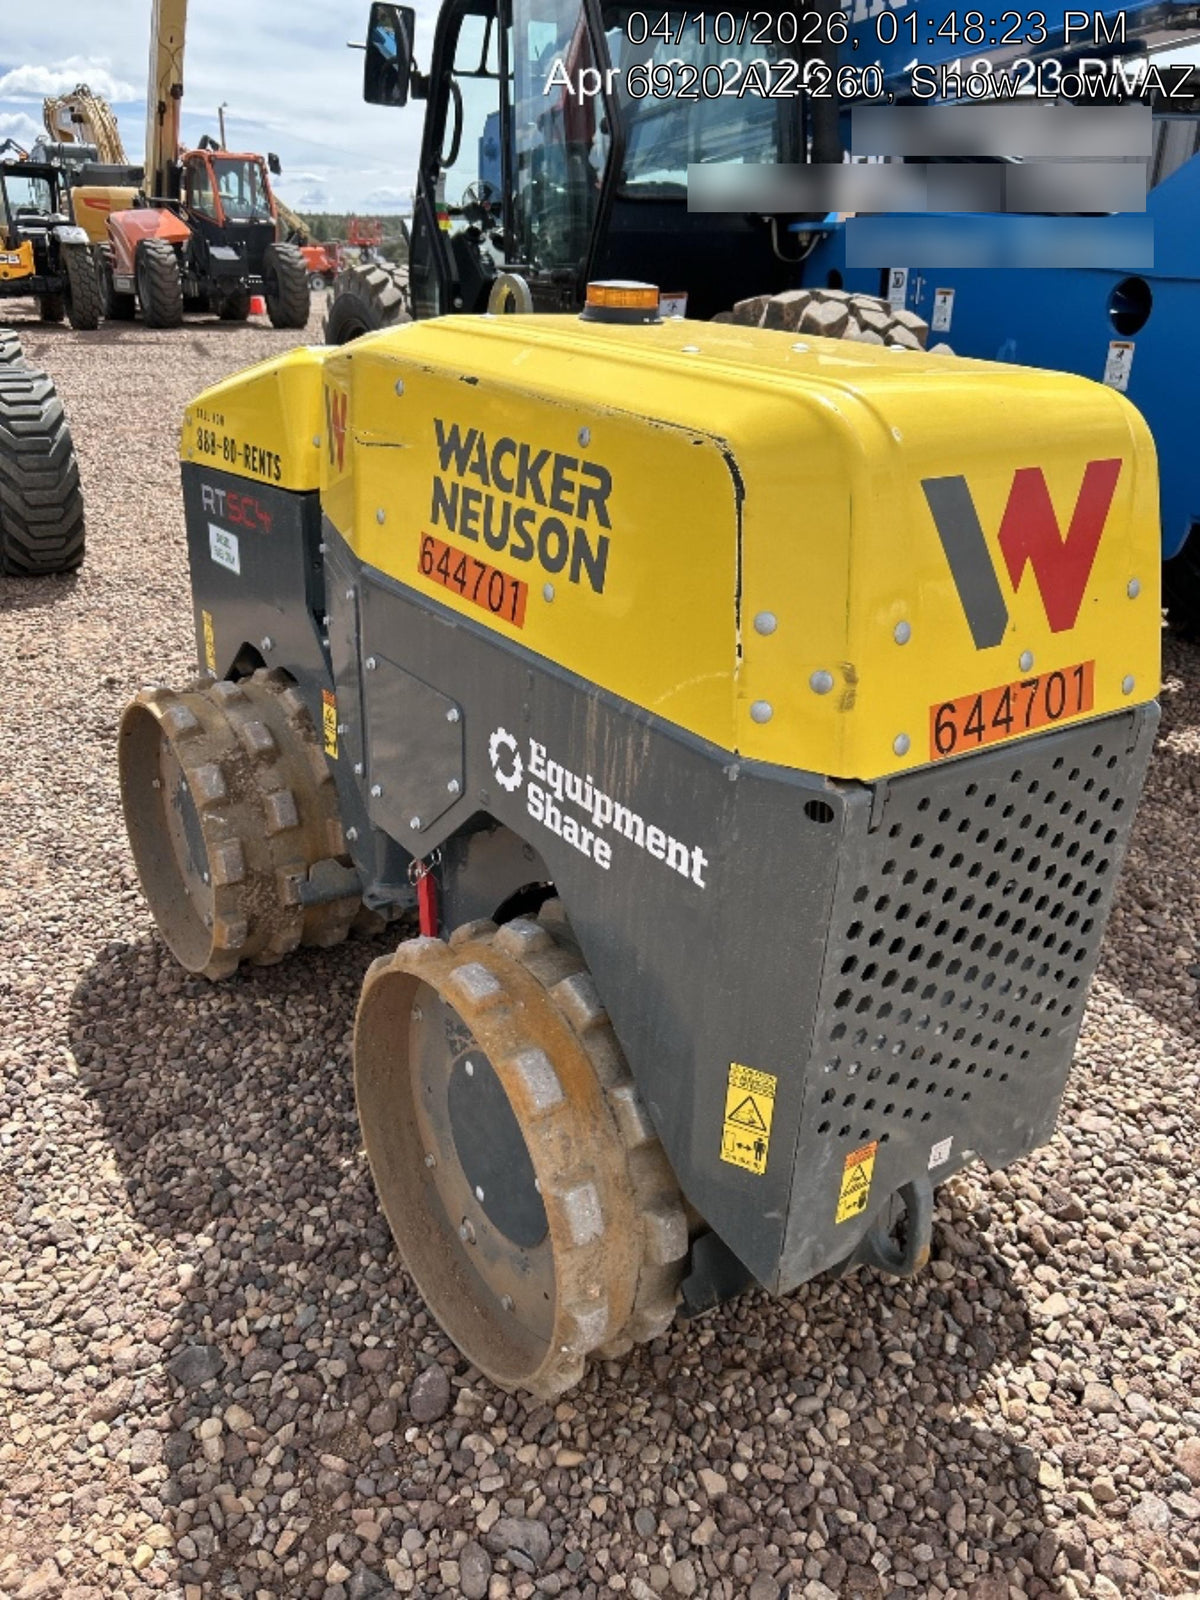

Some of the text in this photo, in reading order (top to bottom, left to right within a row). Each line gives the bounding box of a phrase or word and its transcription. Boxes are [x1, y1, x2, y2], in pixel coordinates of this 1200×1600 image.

[433, 417, 612, 530] WACKER
[420, 536, 520, 621] 644701
[430, 475, 610, 594] NEUSON
[934, 664, 1085, 756] 644701
[527, 737, 709, 889] Equipment
[527, 781, 612, 870] Share
